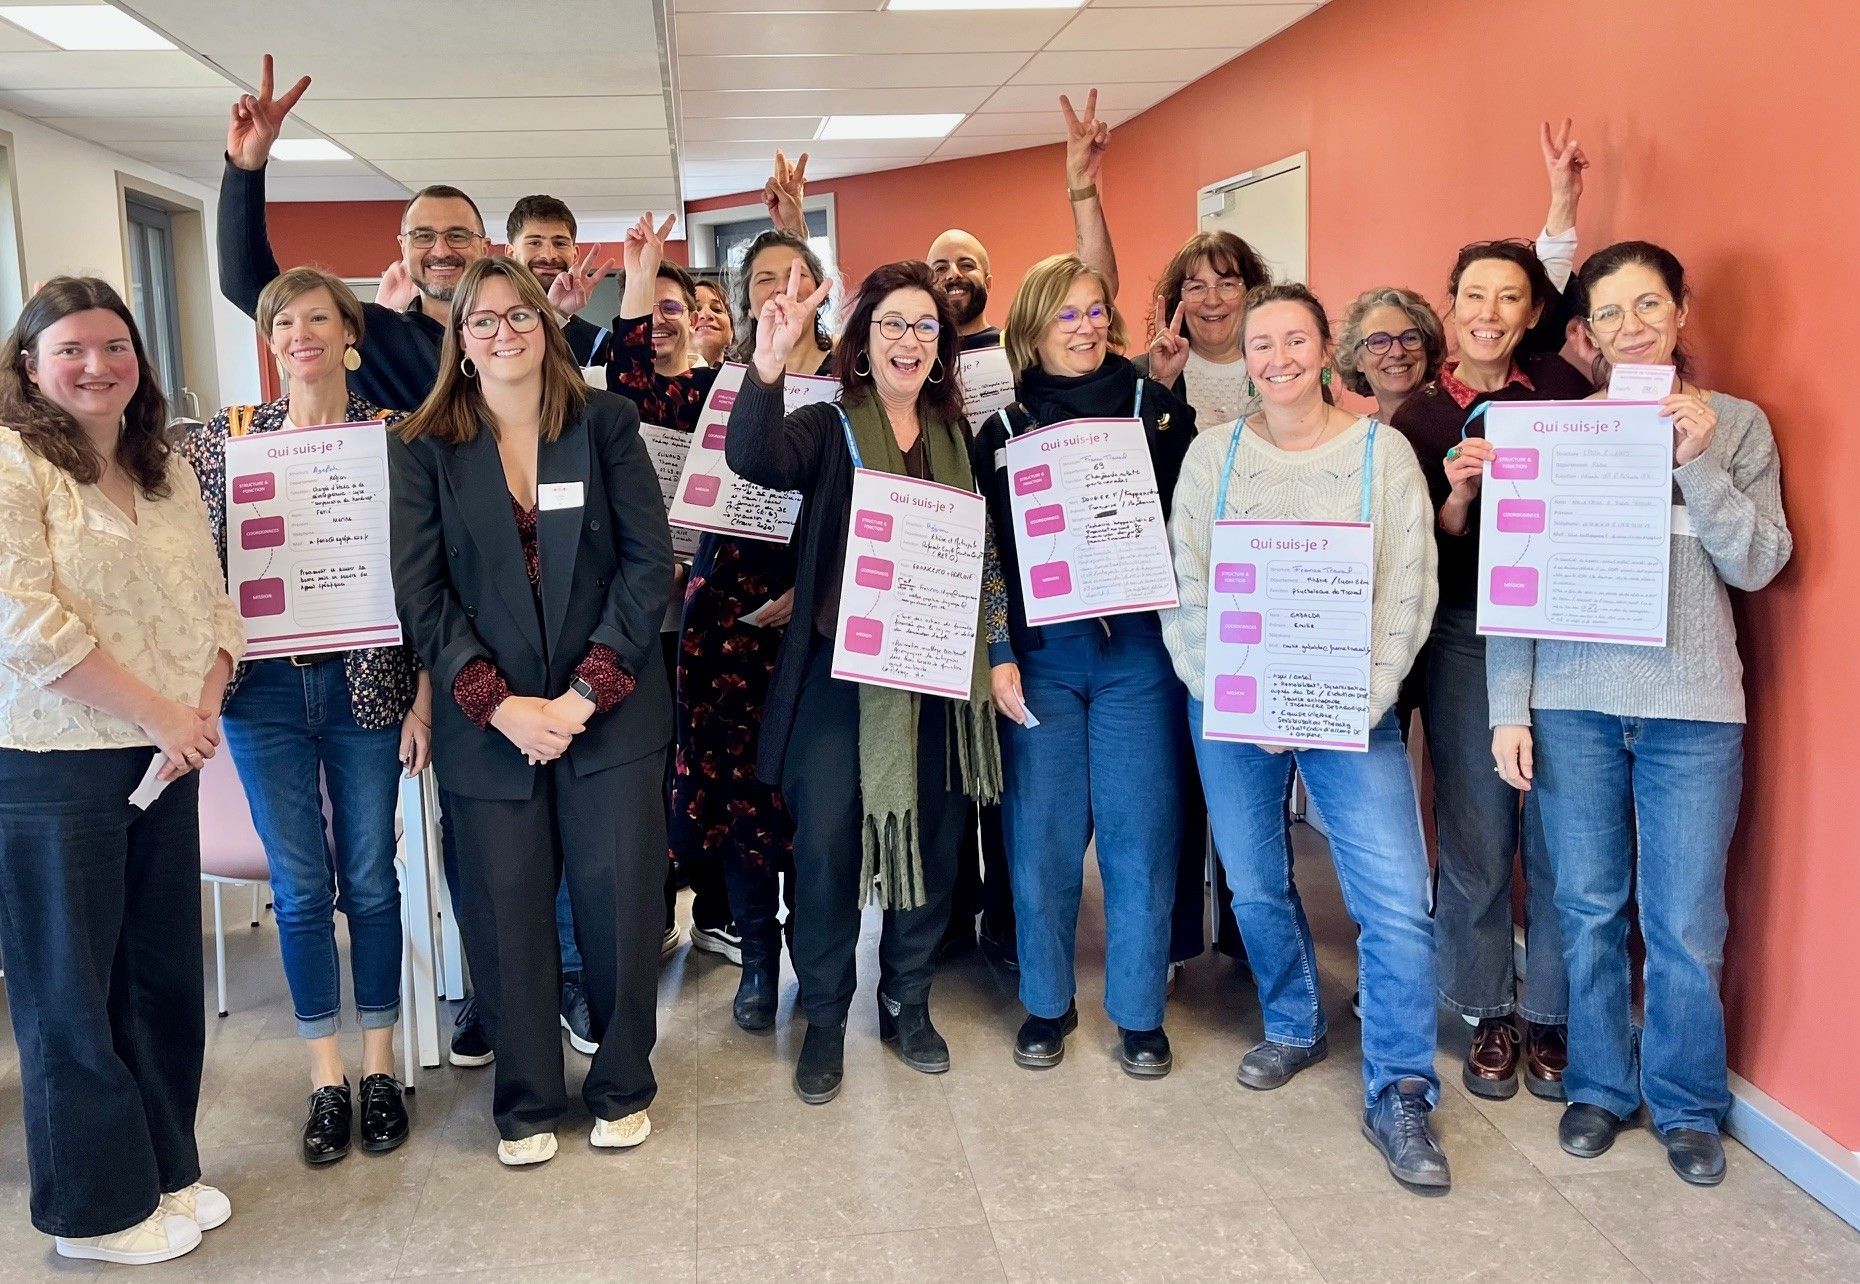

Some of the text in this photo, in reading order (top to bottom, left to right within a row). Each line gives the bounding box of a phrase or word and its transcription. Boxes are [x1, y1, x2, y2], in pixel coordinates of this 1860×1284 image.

[1533, 420, 1621, 435] Qui suis-je ?
[1041, 433, 1109, 452] Qui suis-je ?
[267, 440, 344, 459] Qui suis-je ?
[1093, 462, 1105, 470] 69
[1020, 473, 1040, 481] STRUCTURE
[890, 491, 955, 513] Qui suis-je ?
[861, 518, 883, 526] STRUCTURE
[863, 523, 884, 532] FONCTION
[1250, 539, 1328, 552] Qui suis-je ?
